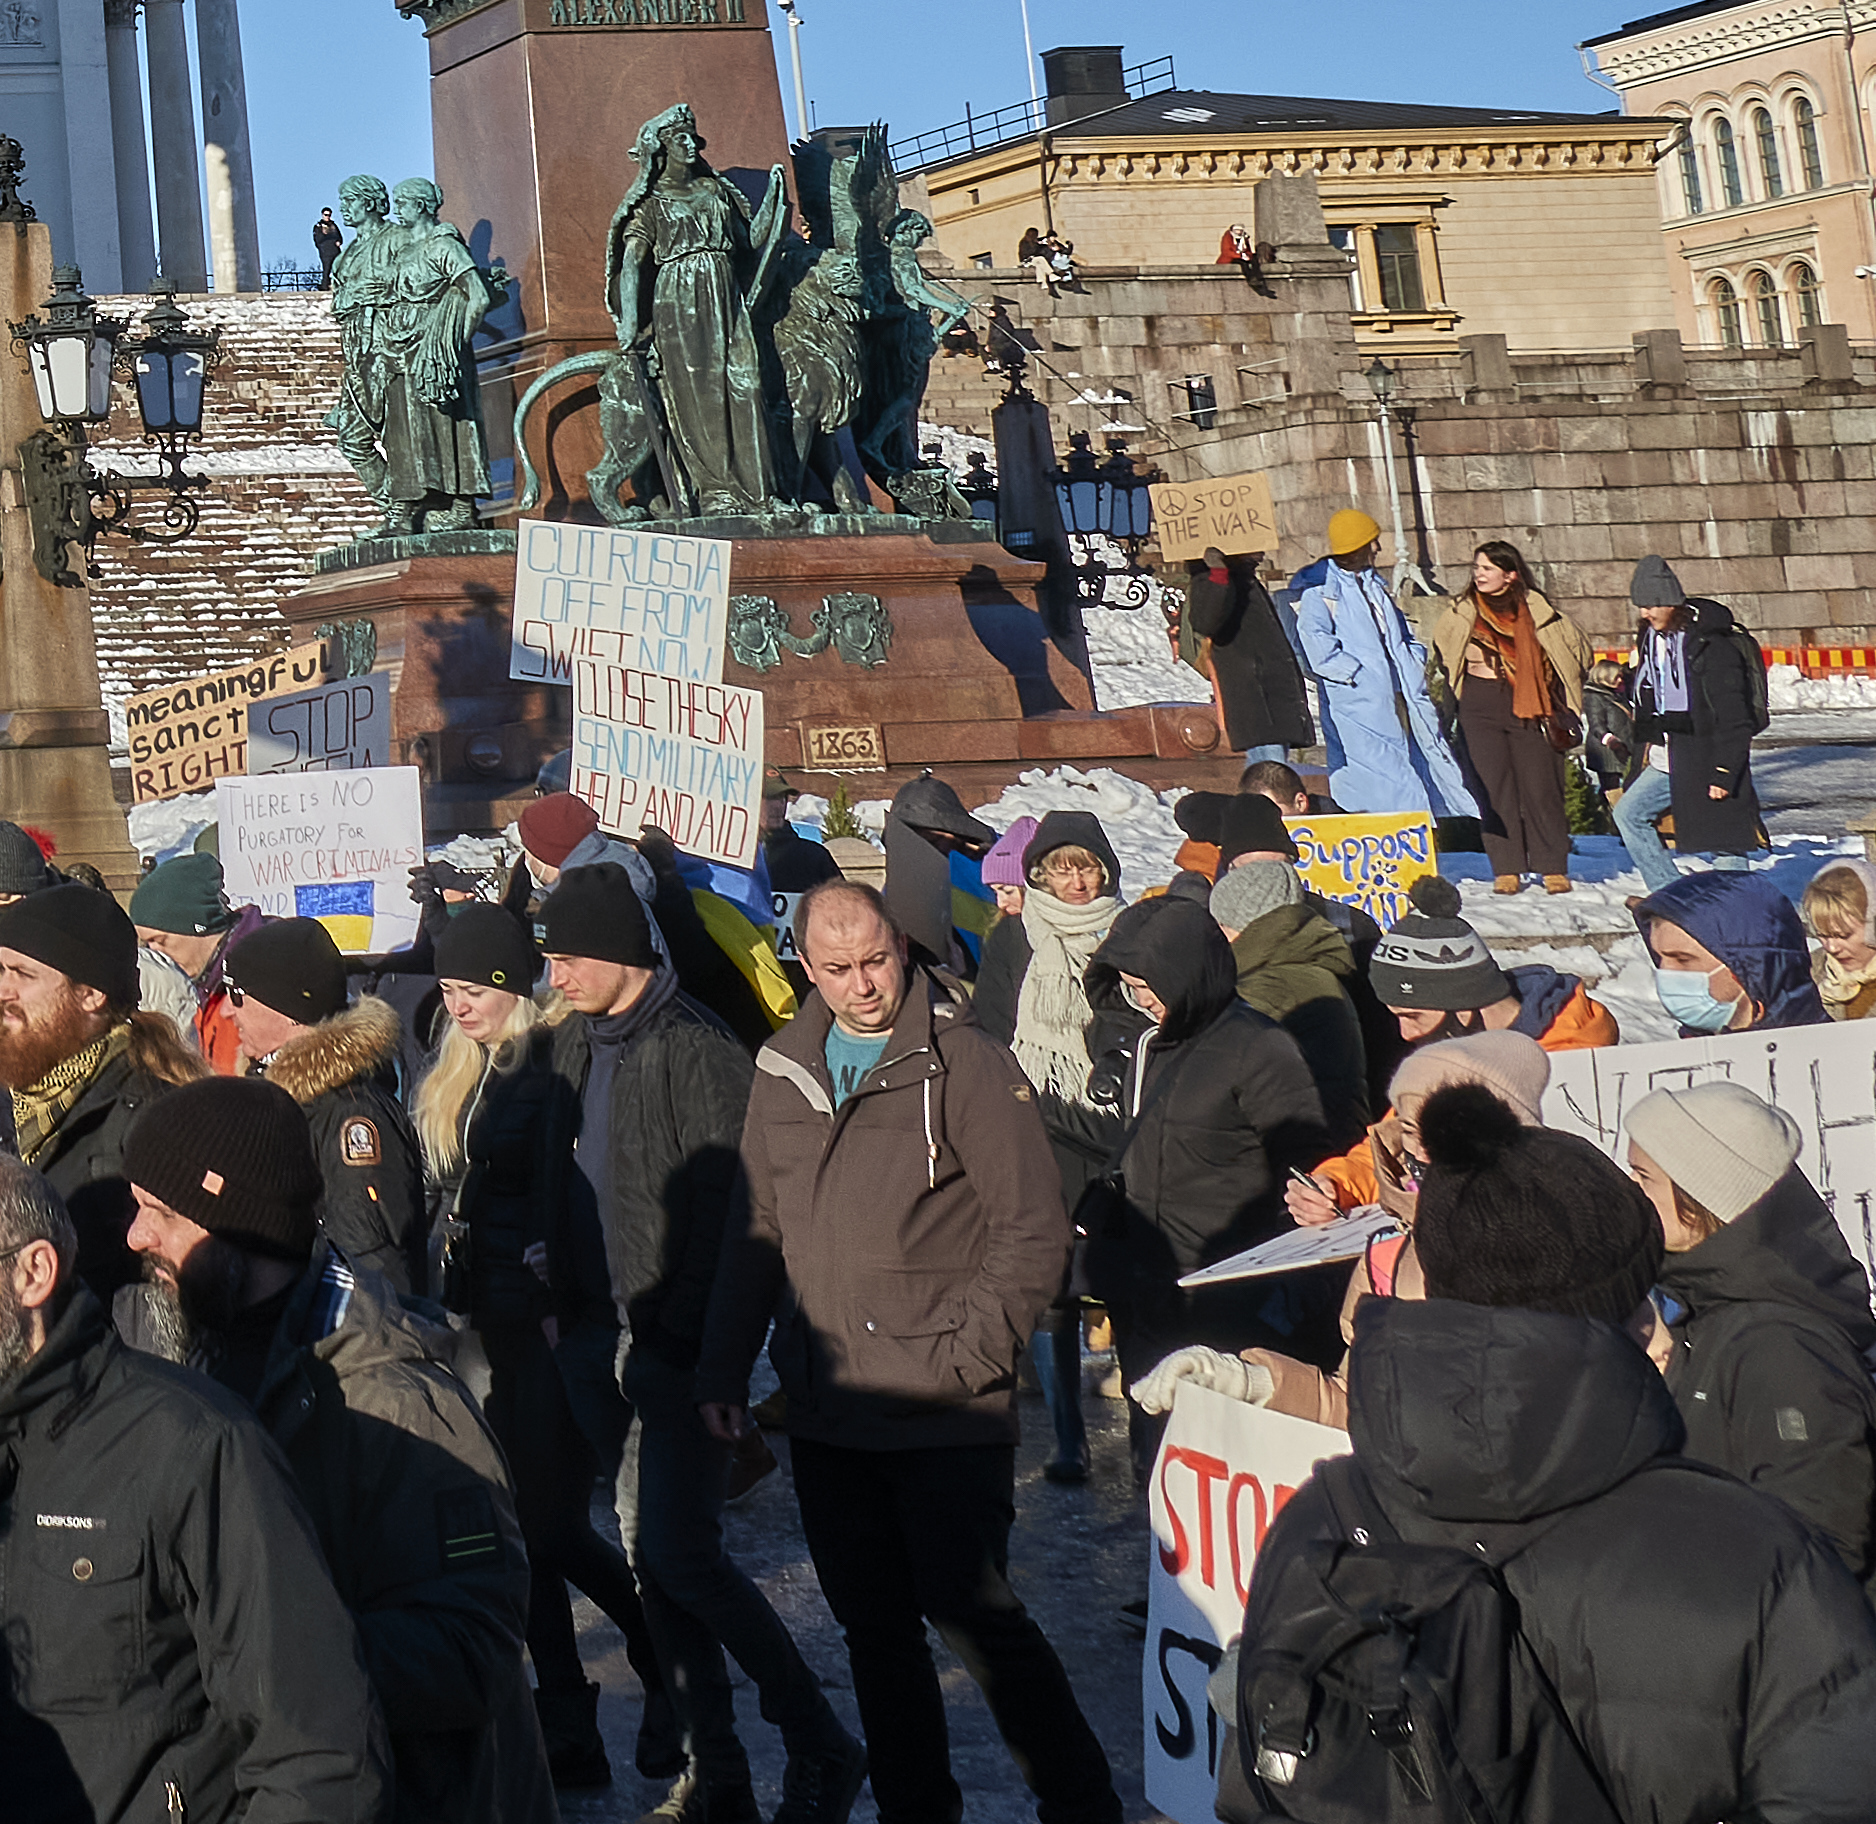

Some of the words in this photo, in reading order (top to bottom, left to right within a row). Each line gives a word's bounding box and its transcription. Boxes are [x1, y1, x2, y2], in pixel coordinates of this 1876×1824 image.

[1159, 516, 1200, 545] THE
[1211, 508, 1271, 536] WAR
[1191, 485, 1252, 513] STOP
[527, 525, 604, 578] CUT
[607, 533, 723, 594] RUSSIA
[540, 577, 613, 627] OFF
[619, 585, 712, 643] FROM
[127, 643, 329, 727] meaningful
[639, 636, 713, 682] NOW
[268, 684, 374, 768] STOP
[576, 660, 658, 731] CLOSE
[660, 676, 705, 740] THE
[704, 685, 752, 752] SKY
[134, 739, 247, 801] RIGHT
[576, 718, 643, 780] SEND
[646, 733, 756, 807] MILITARY
[223, 783, 292, 827] THERE
[332, 776, 374, 807] NO
[576, 767, 638, 829] HELP
[640, 785, 695, 847] AND
[692, 800, 749, 860] AID
[238, 824, 326, 853] PURGATORY
[337, 822, 366, 850] FOR
[248, 850, 296, 887] WAR
[300, 846, 418, 882] CRIMINALS
[230, 892, 288, 915] STND
[1159, 1443, 1298, 1610] STO
